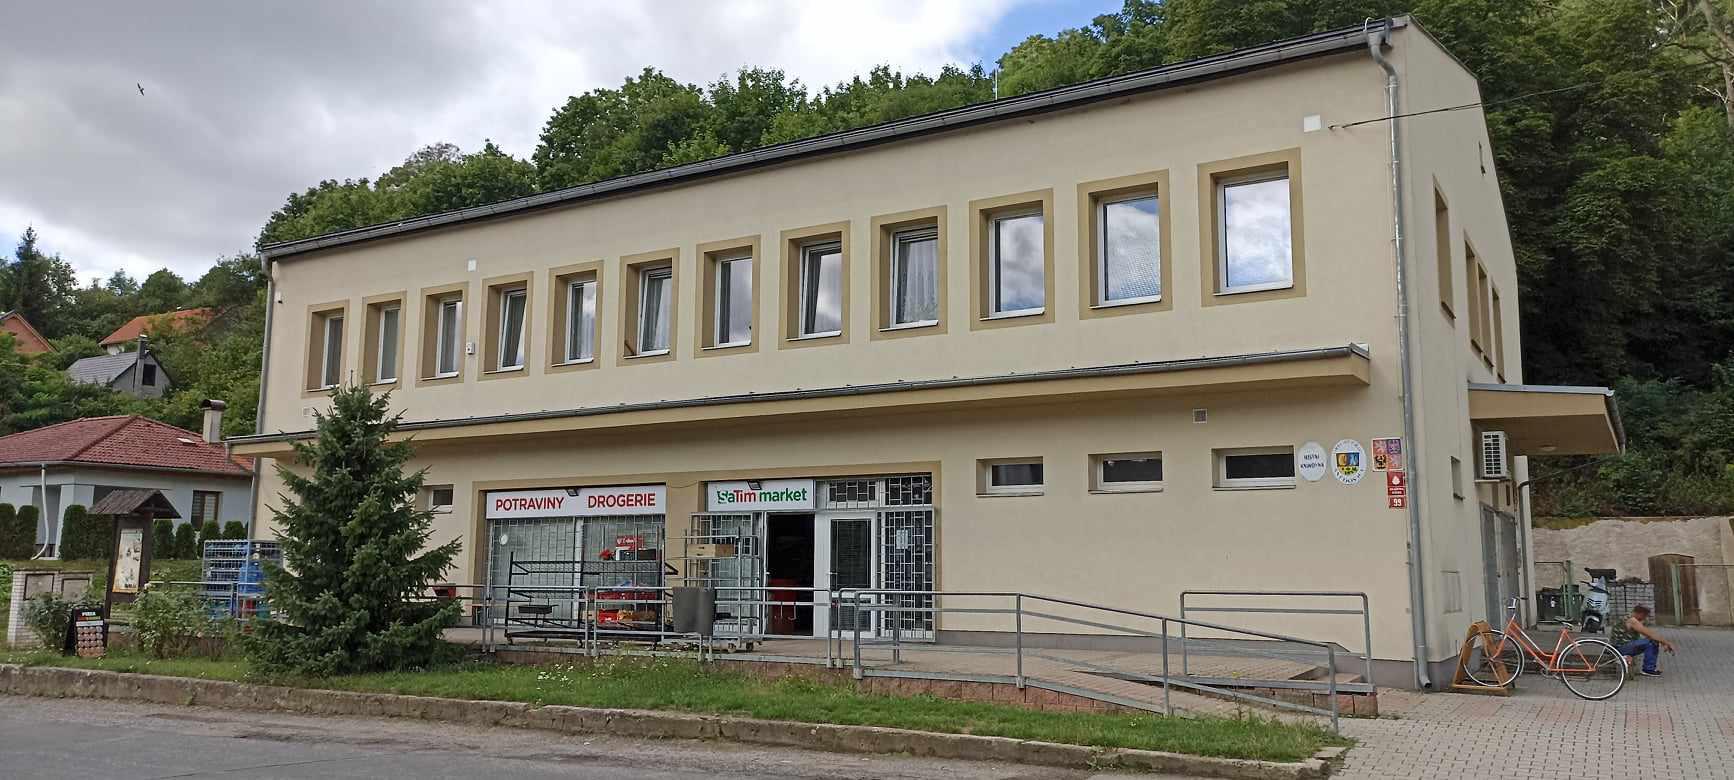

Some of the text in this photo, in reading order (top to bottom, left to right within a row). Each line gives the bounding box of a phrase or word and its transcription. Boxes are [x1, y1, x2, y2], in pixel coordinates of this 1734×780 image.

[495, 493, 656, 511] POTRAVINY DROGERIE
[759, 488, 808, 502] market
[1393, 499, 1402, 507] 99
